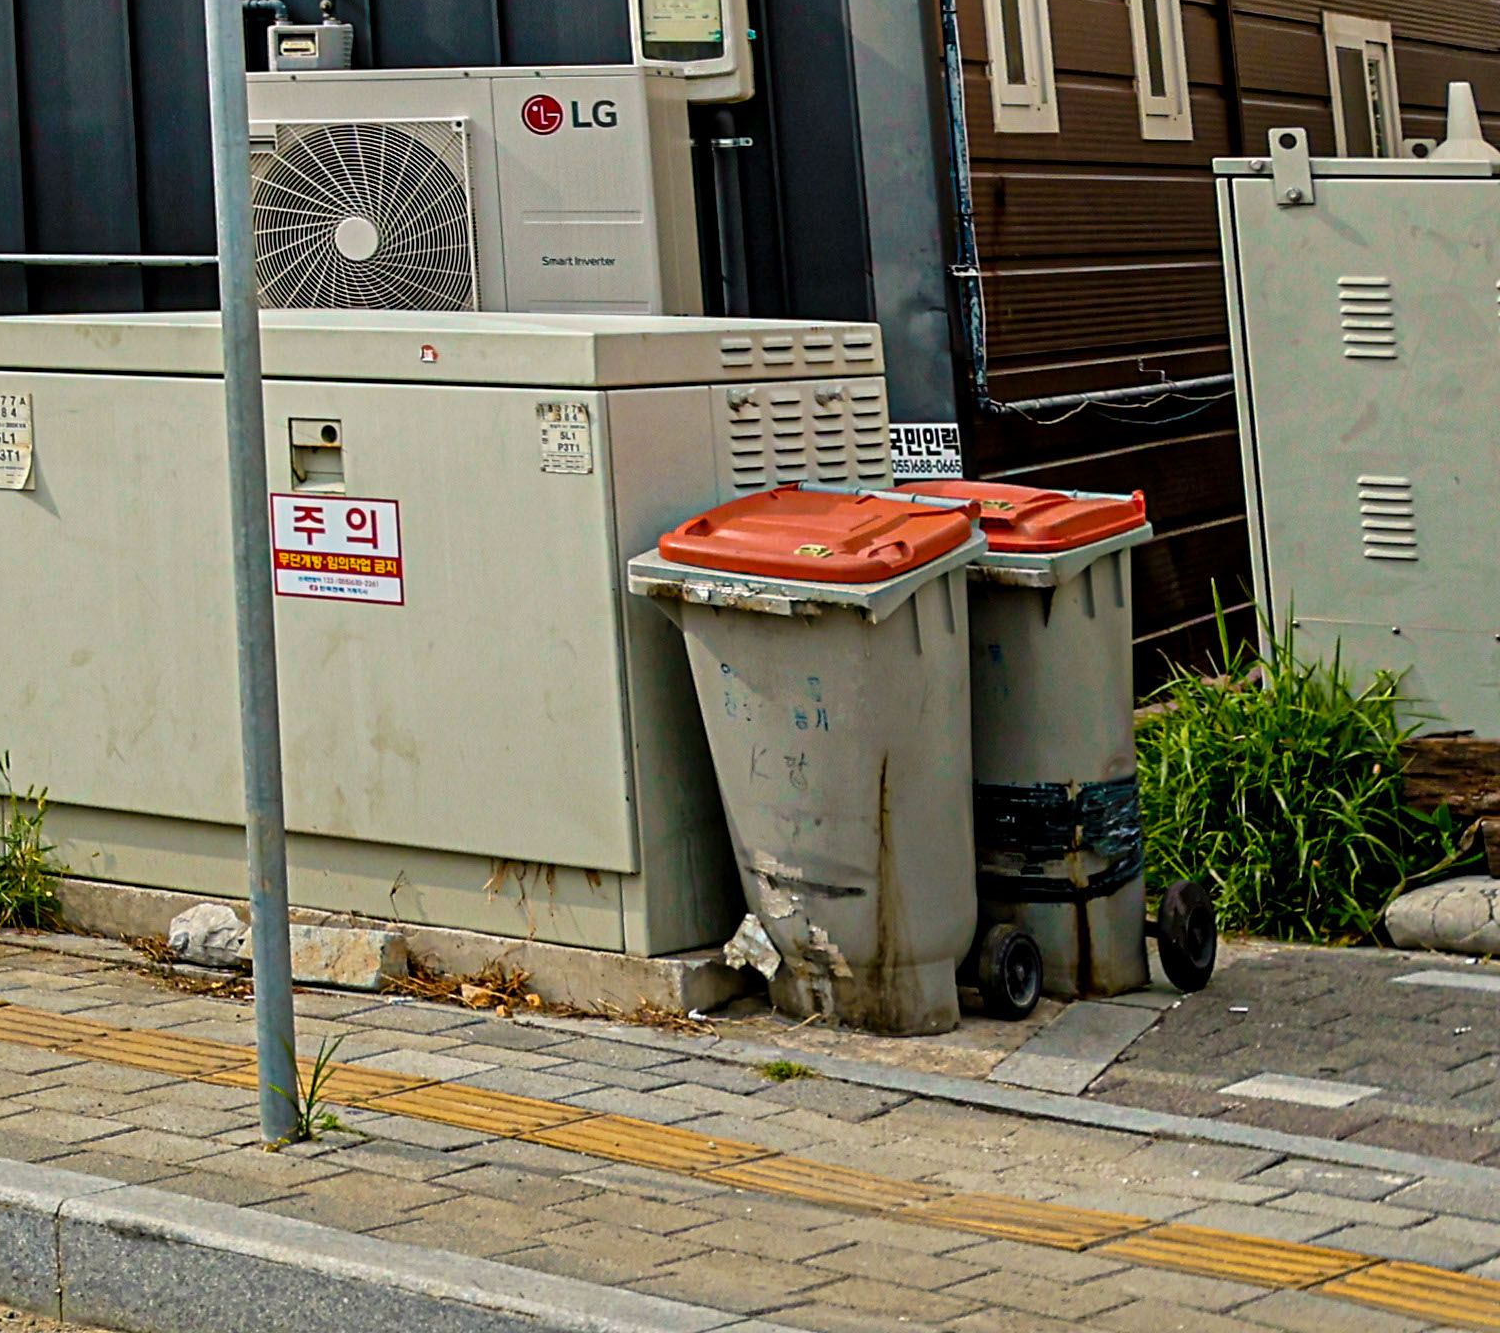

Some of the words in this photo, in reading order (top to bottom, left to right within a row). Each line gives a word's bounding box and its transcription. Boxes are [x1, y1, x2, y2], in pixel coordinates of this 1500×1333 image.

[571, 100, 617, 128] LG
[542, 256, 573, 266] Smart
[575, 256, 615, 266] Inverter
[889, 428, 960, 456] 국민인력
[293, 505, 378, 550] 주의
[374, 559, 397, 574] 금지
